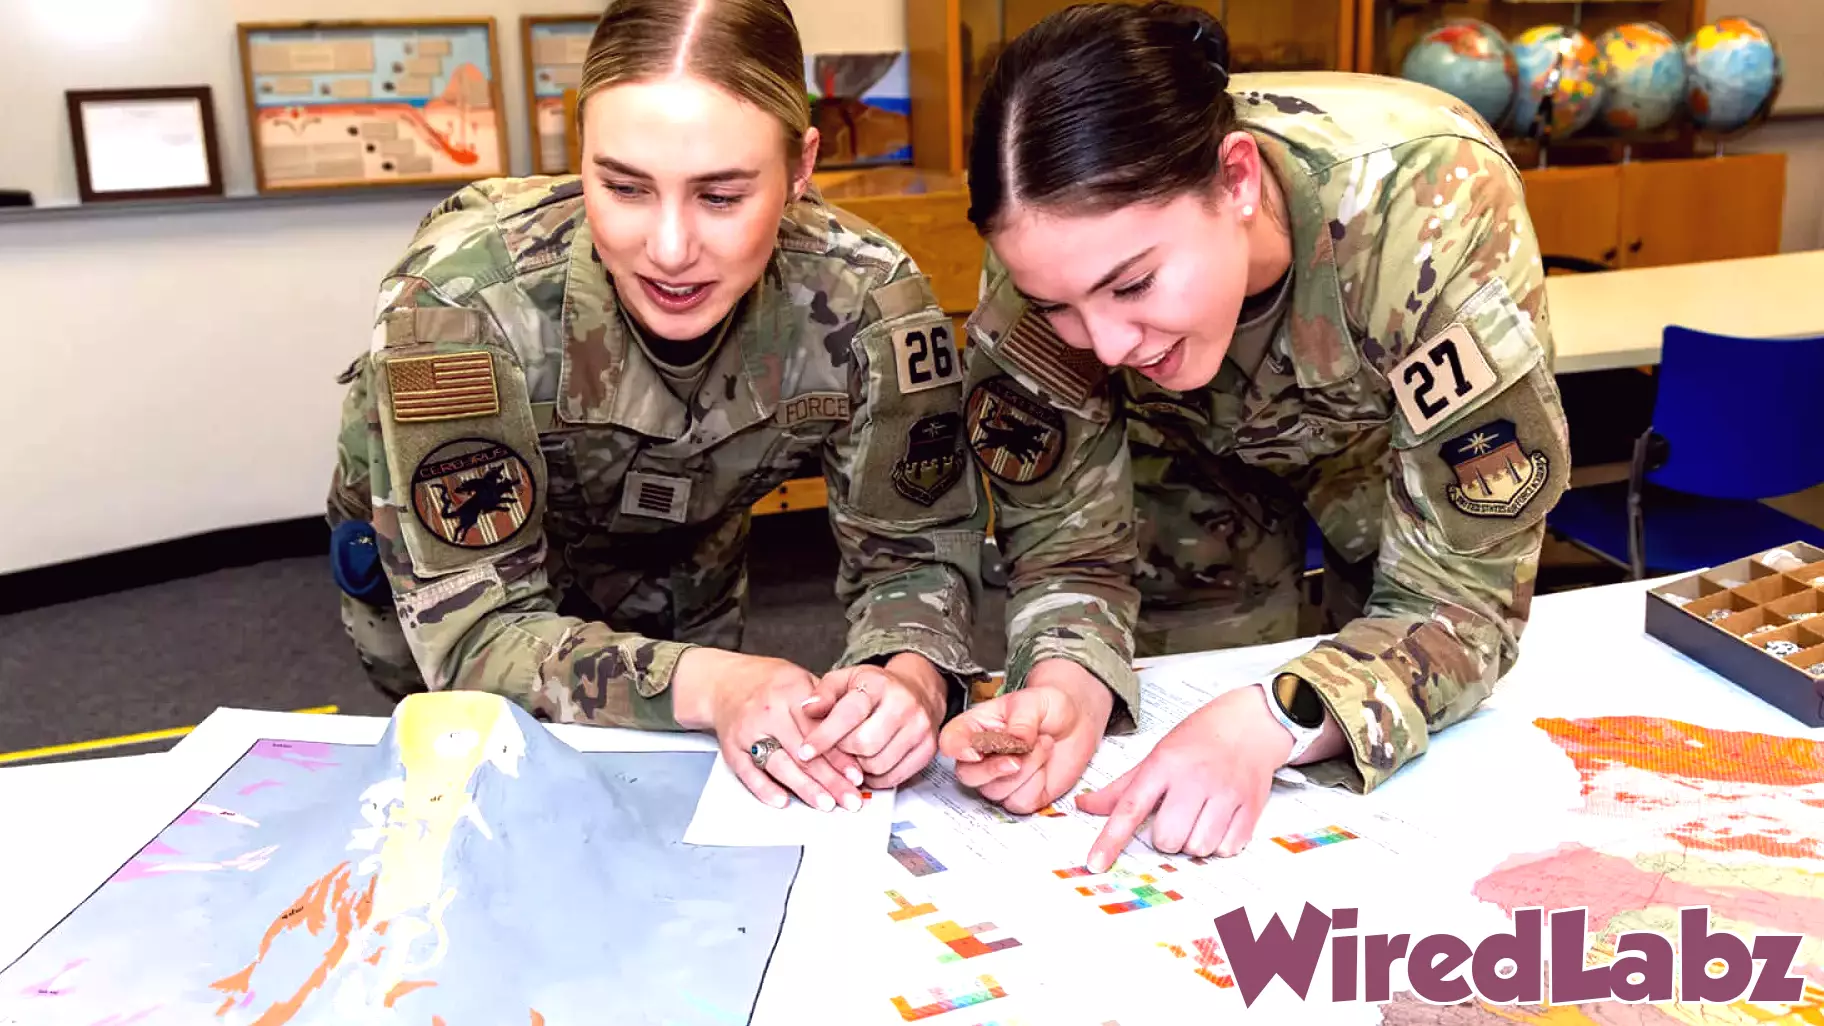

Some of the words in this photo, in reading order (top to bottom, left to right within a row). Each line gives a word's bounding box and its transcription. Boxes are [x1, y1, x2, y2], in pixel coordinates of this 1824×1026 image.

[905, 326, 951, 384] 26
[1403, 338, 1473, 420] 27
[786, 397, 848, 423] FORCE
